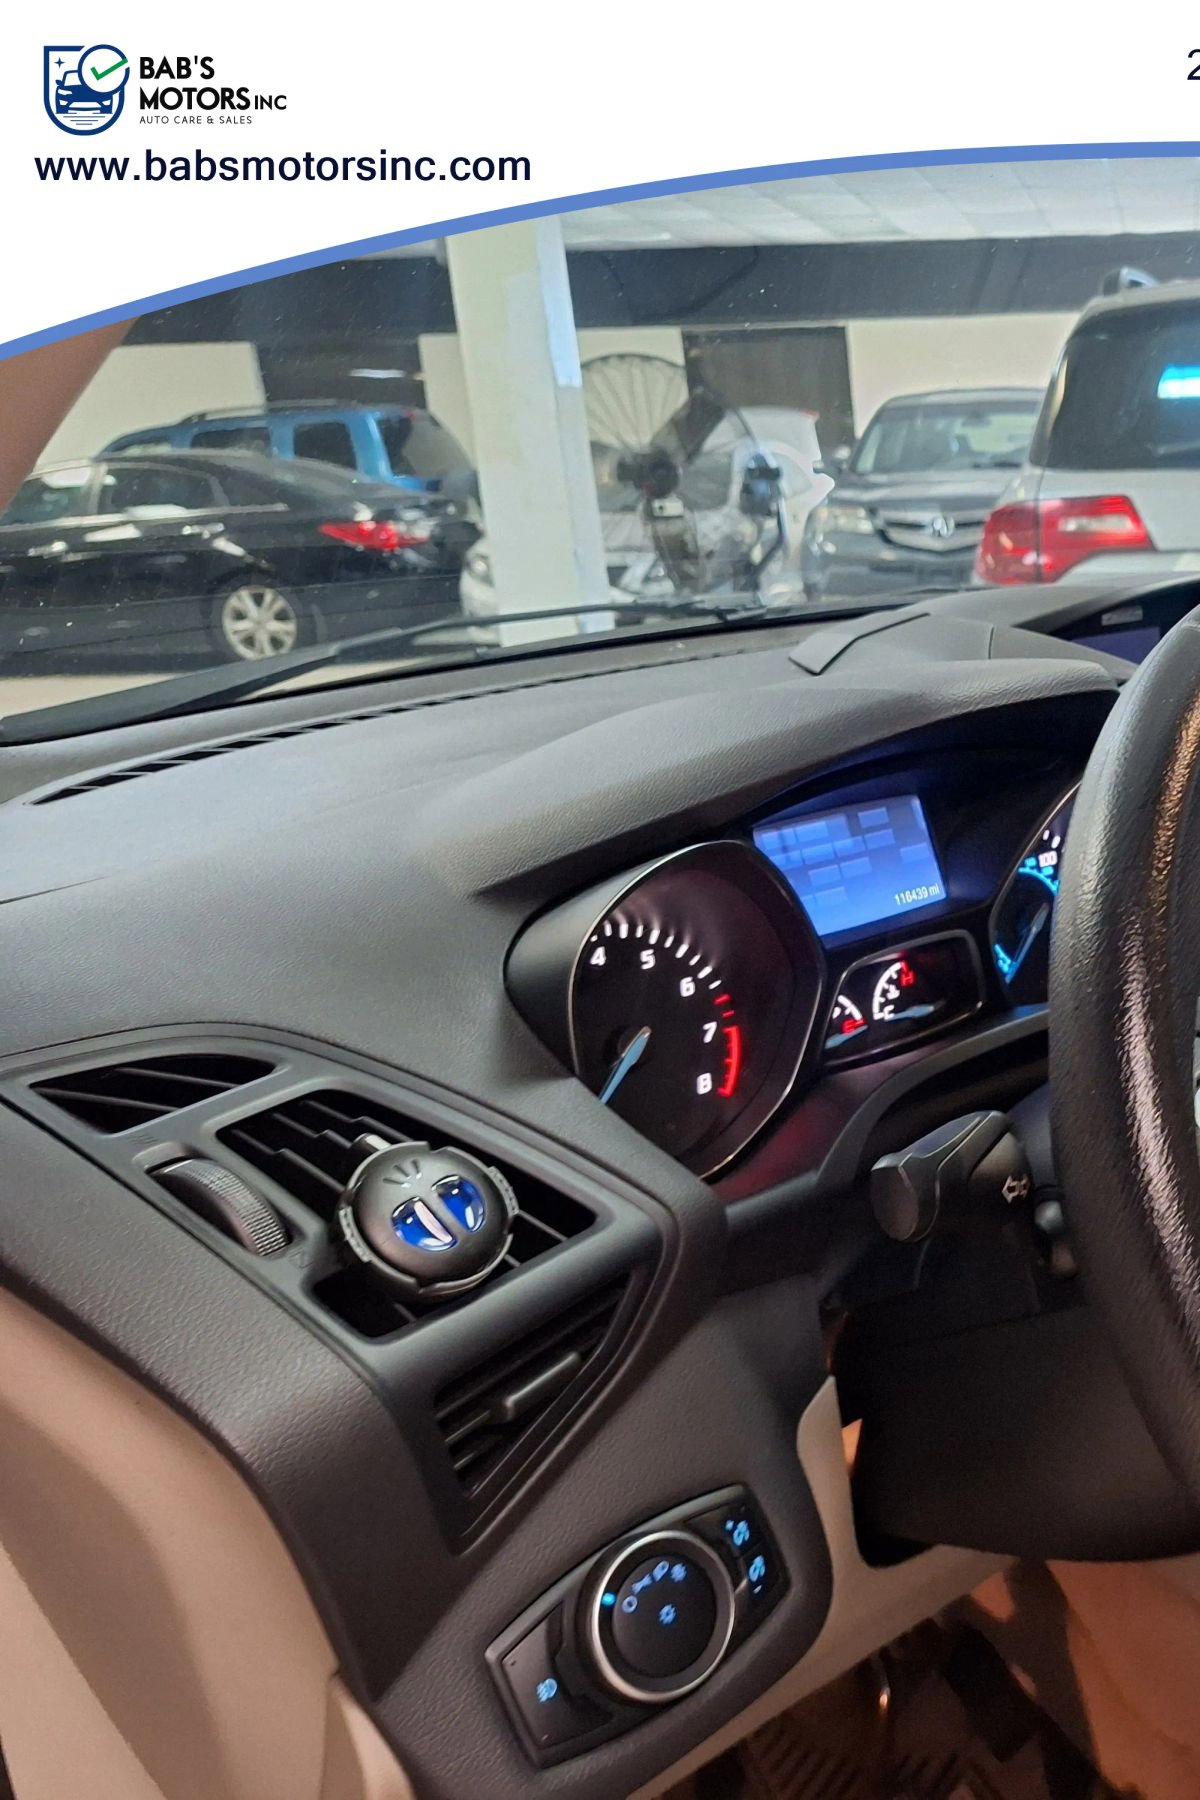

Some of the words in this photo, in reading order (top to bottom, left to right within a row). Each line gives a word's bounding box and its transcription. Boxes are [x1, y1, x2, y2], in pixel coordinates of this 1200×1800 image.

[894, 886, 929, 905] 116439
[590, 946, 606, 966] 4
[640, 948, 656, 970] 5
[680, 976, 696, 997] 6
[702, 1021, 717, 1043] 7
[696, 1072, 712, 1095] 8
